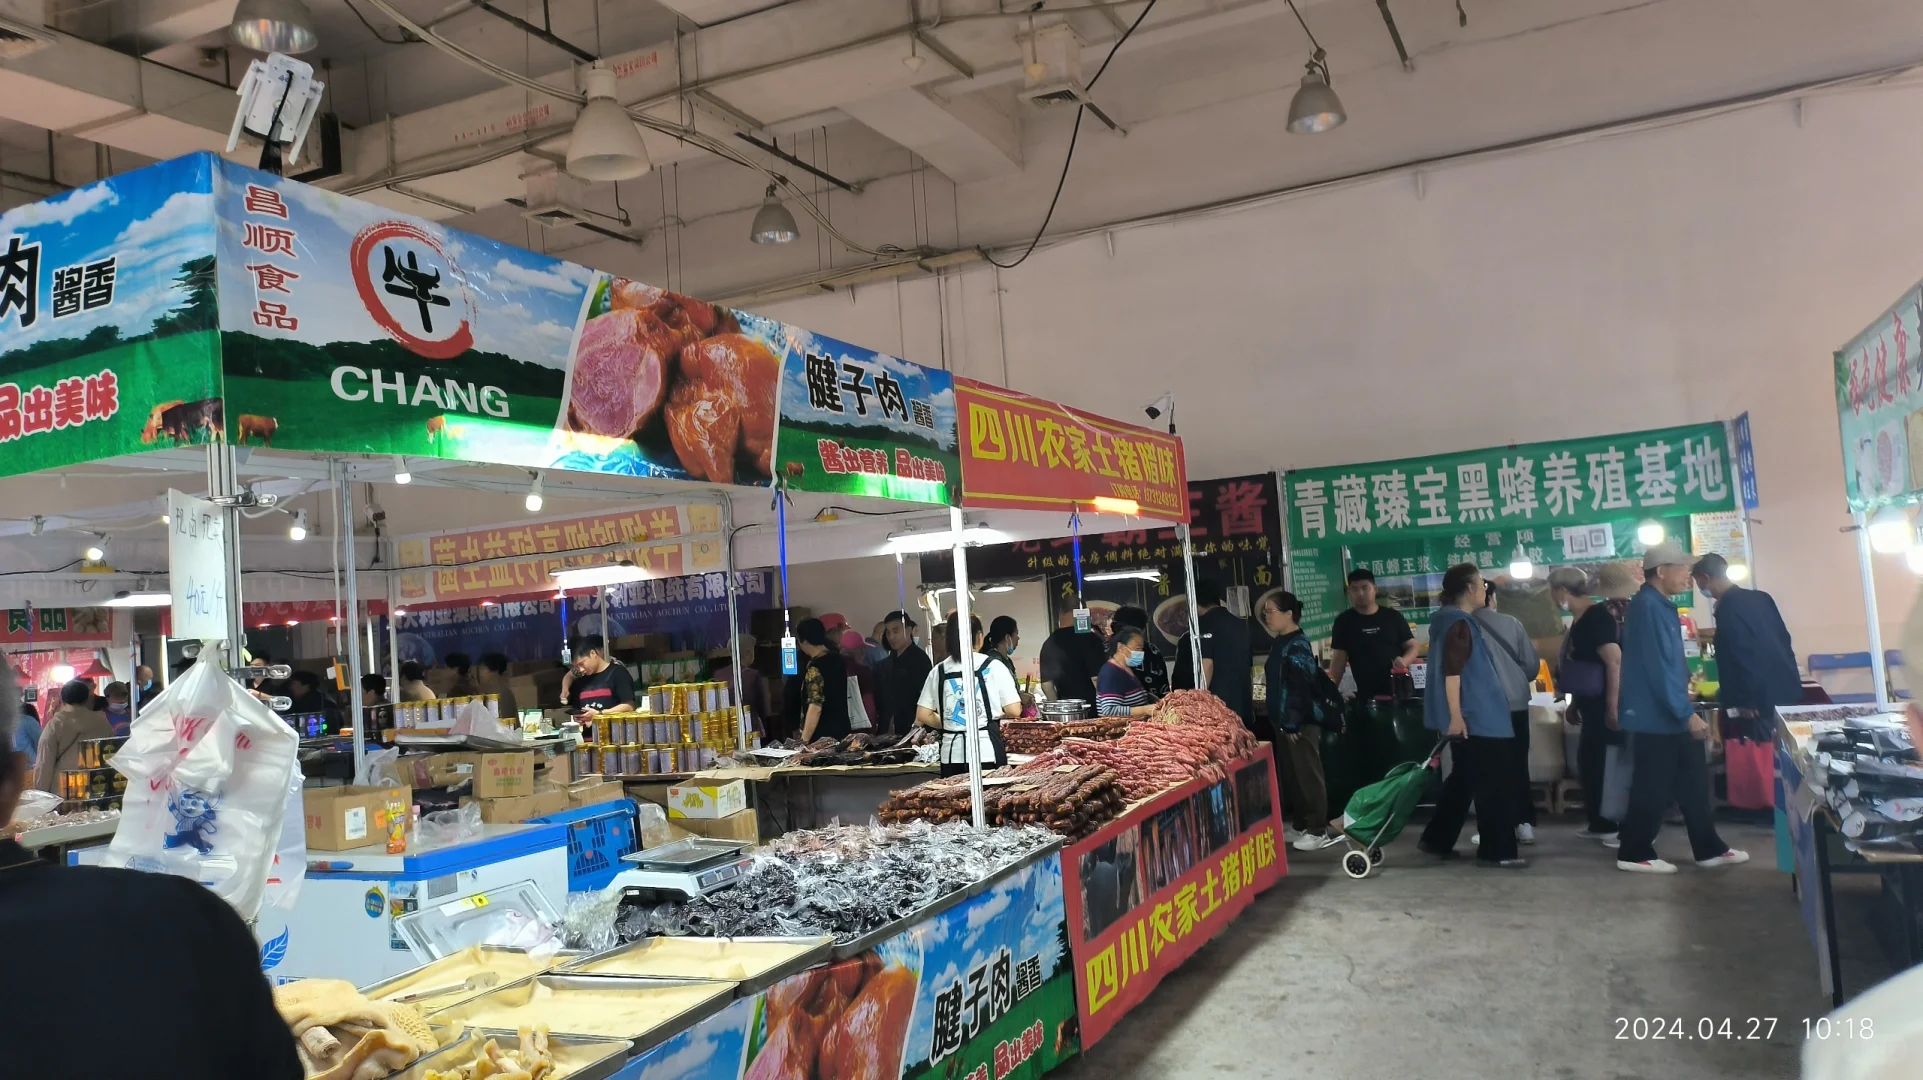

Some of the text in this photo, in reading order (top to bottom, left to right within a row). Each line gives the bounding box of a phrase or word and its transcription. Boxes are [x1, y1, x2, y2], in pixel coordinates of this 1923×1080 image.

[242, 183, 299, 332] 昌顺食品
[0, 368, 119, 443] 品出美味
[330, 365, 511, 418] CHANG
[806, 353, 910, 424] 腱子肉
[818, 437, 948, 485] 酱出营养 品出美味
[968, 402, 1178, 488] 四川农家土猪腊味
[1294, 436, 1728, 539] 青藏臻宝黑蜂养殖基地
[415, 628, 458, 640] AUSTRALIAN
[656, 606, 690, 617] AOCHUN
[930, 944, 1012, 1067] 腱子肉
[994, 1018, 1044, 1080] 品出美味
